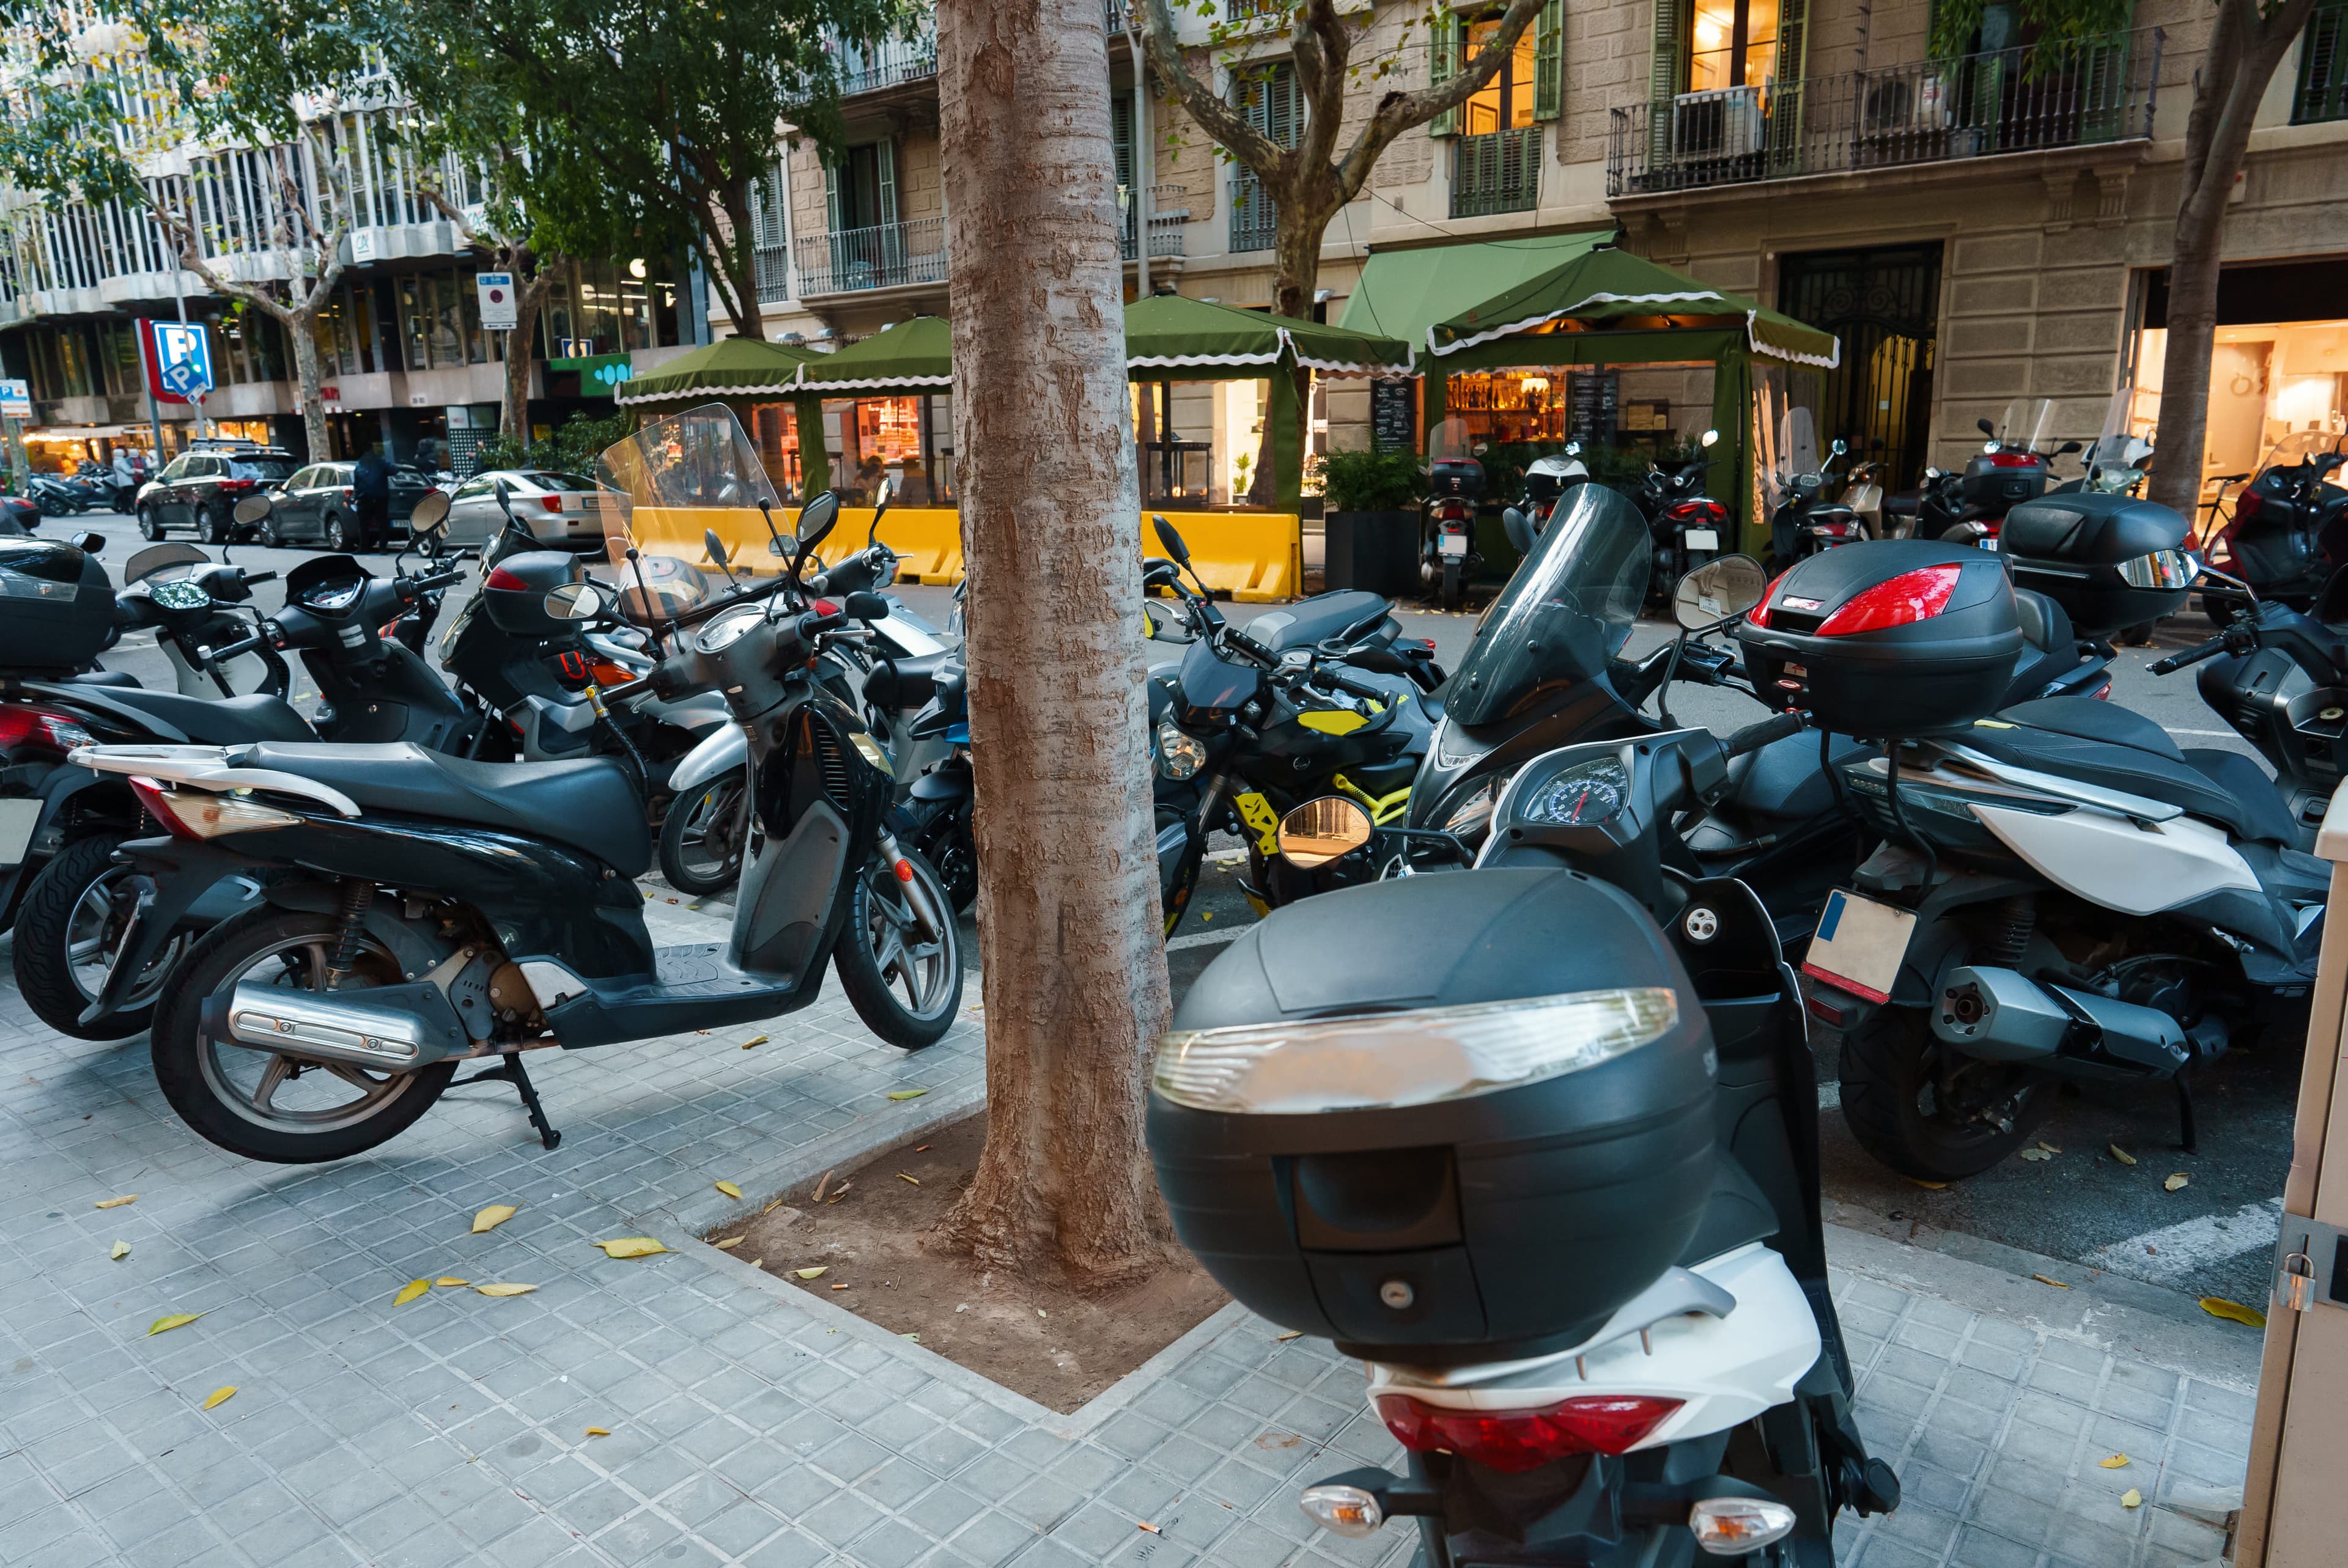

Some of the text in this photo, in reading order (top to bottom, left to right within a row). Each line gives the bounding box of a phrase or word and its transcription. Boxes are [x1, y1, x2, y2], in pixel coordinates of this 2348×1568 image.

[166, 329, 197, 364] P
[169, 366, 190, 391] P
[2, 387, 10, 396] P
